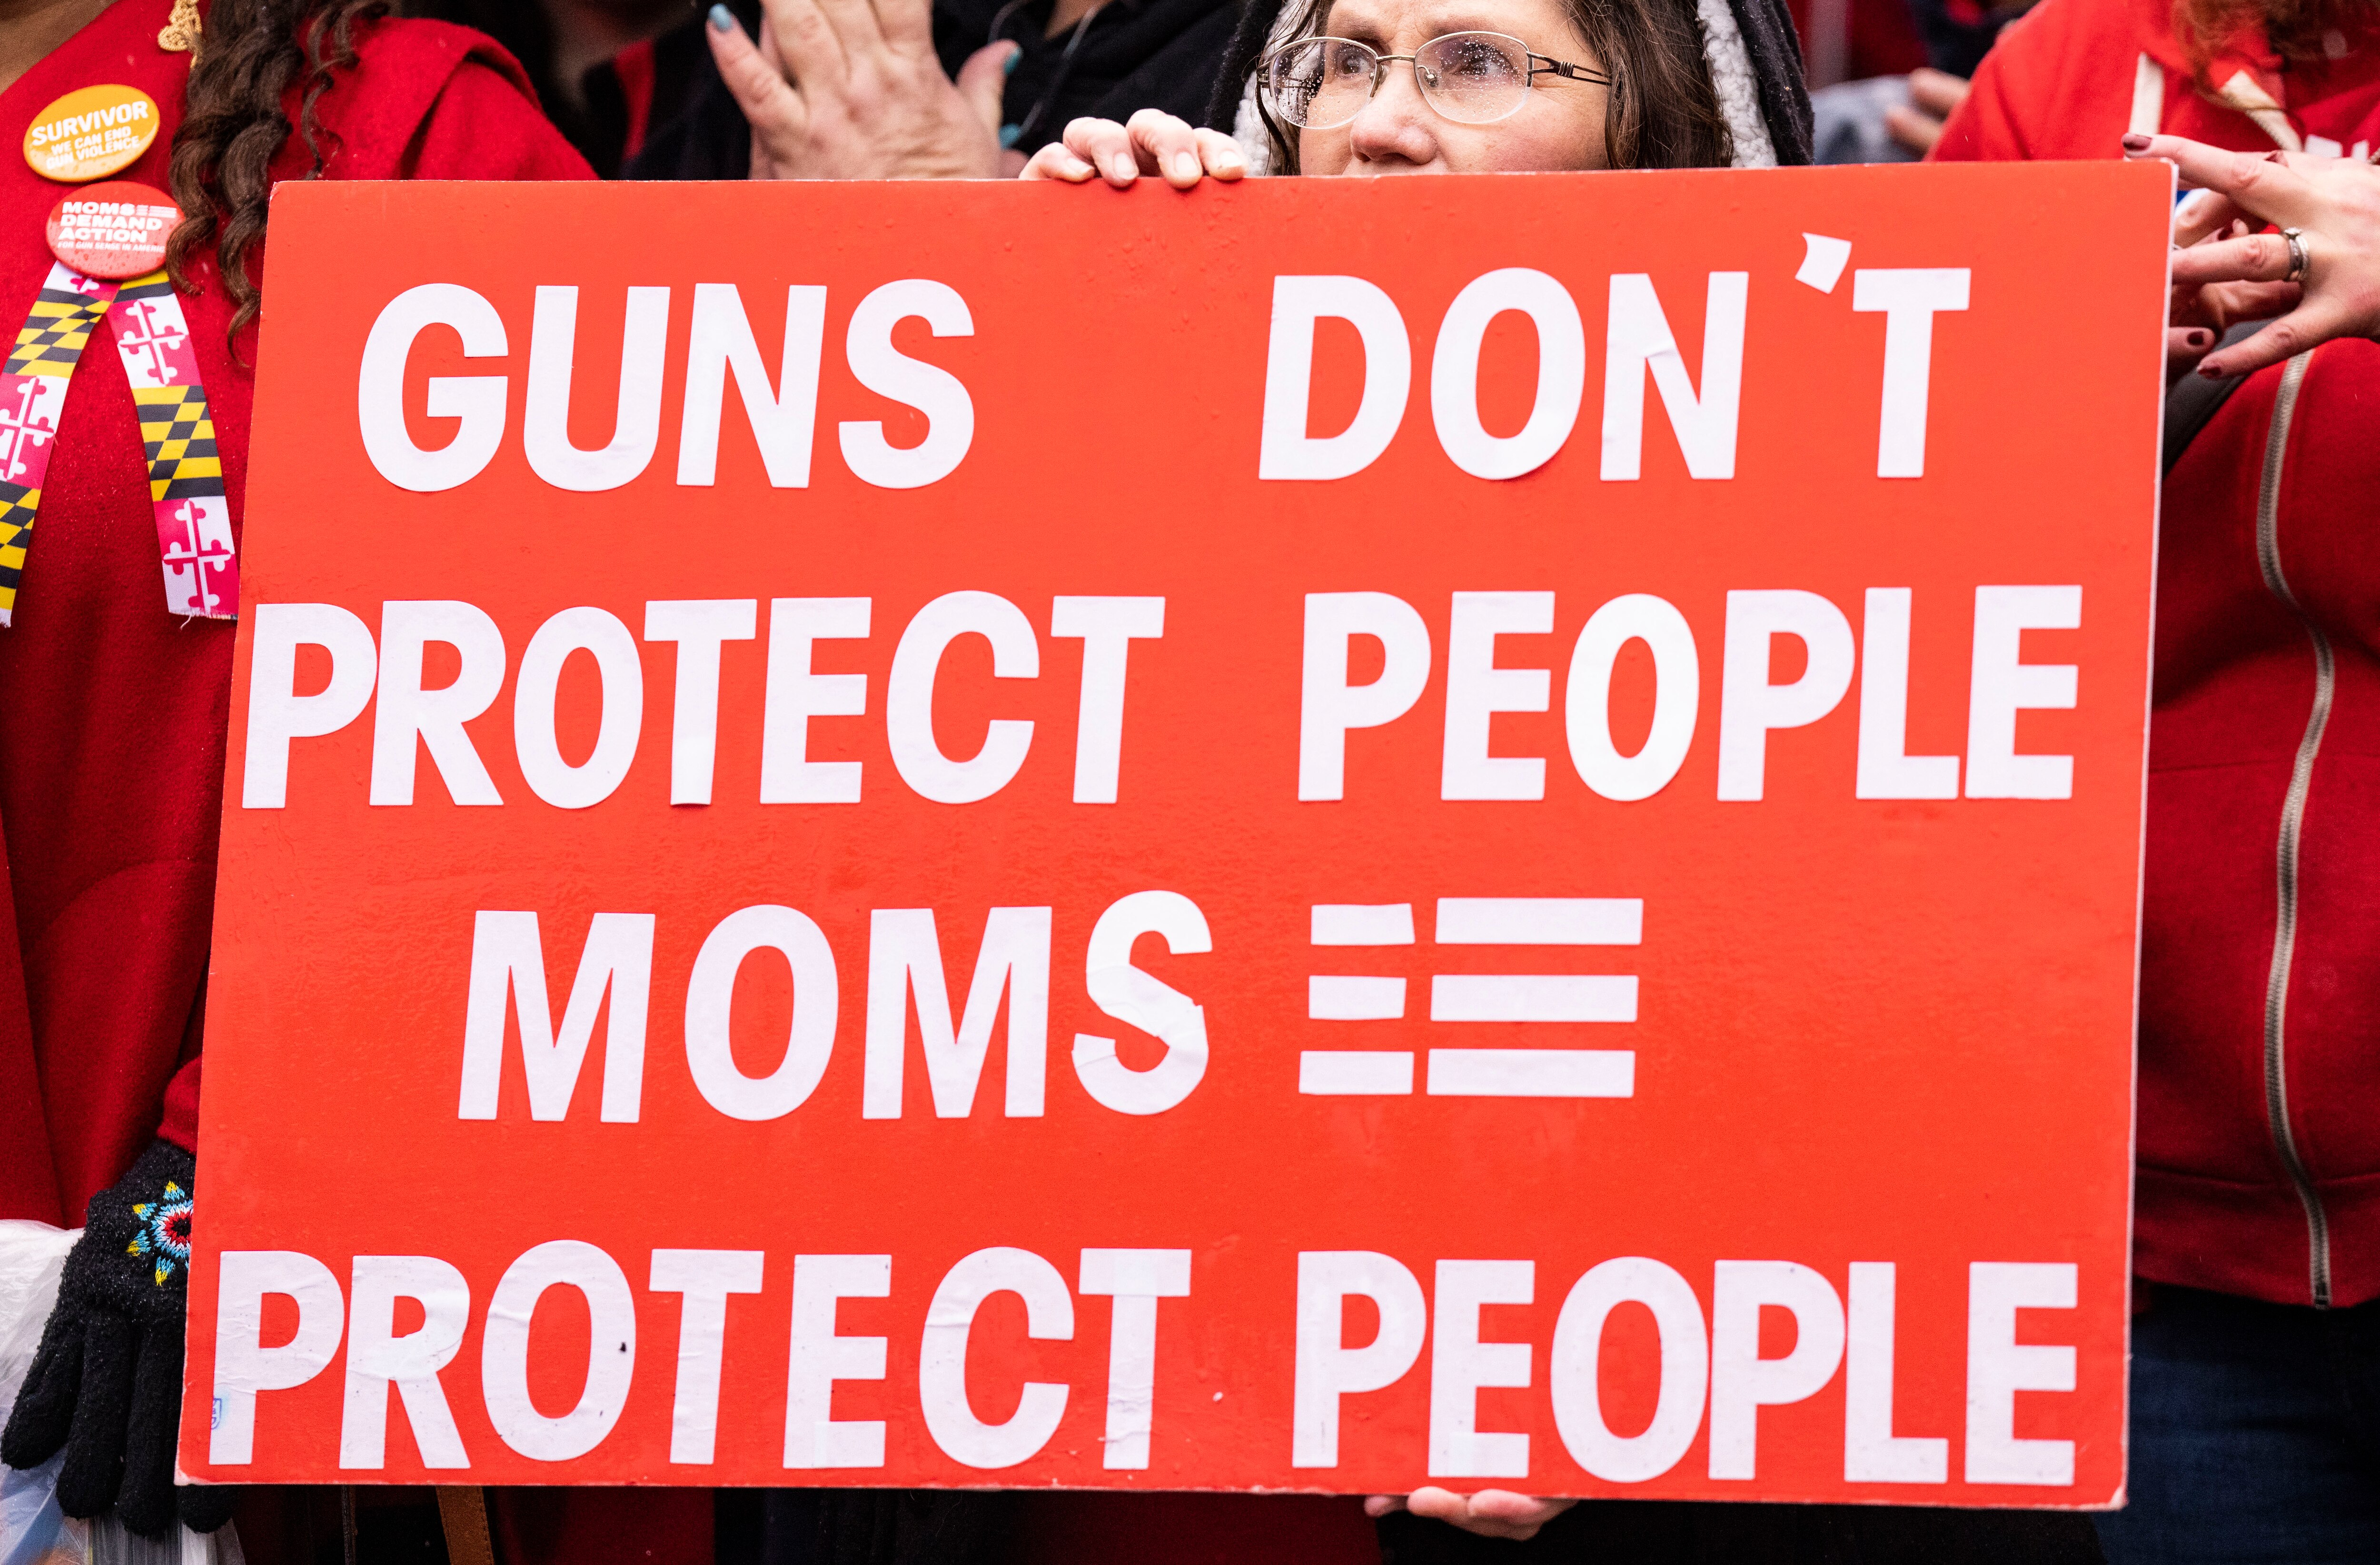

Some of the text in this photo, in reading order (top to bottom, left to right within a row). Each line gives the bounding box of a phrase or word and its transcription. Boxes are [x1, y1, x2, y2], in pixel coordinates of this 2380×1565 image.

[31, 100, 149, 146] SURVIVOR
[46, 135, 140, 170] GUN VIOLENCE
[50, 126, 131, 156] WE CAN END
[60, 214, 162, 230] DEMAND
[62, 201, 135, 216] MOMS
[58, 227, 148, 243] ACTION
[58, 241, 166, 254] FOR GUN SENSE IN AMERIC
[358, 279, 974, 491] GUNS
[242, 586, 2082, 808] PROTECT PEOPLE
[459, 890, 1212, 1122] MOMS
[209, 1240, 2077, 1485] PROTECT PEOPLE
